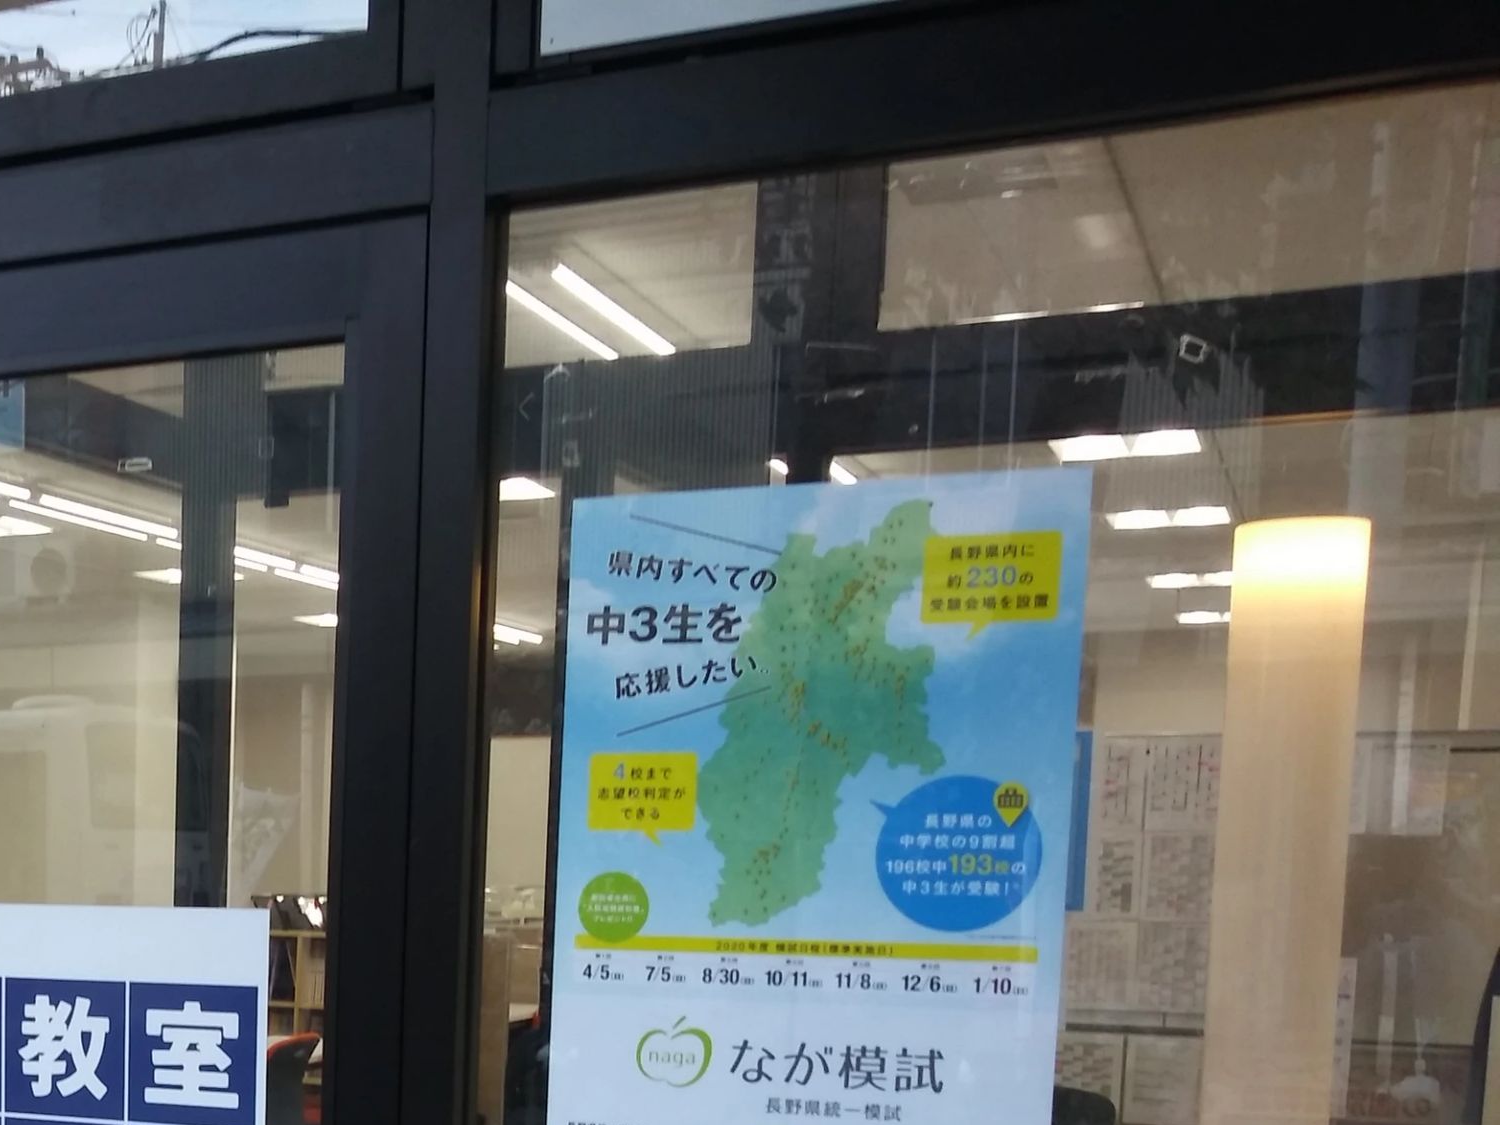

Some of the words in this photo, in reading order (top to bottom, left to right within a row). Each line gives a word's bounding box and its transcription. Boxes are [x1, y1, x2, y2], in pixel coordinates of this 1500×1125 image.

[608, 551, 778, 593] 県内すべての
[586, 602, 743, 646] 中3生を
[925, 813, 993, 830] 長野県の
[648, 1048, 697, 1068] naga
[729, 1038, 946, 1095] なが模試
[765, 1096, 903, 1123] 長野県統一模試
